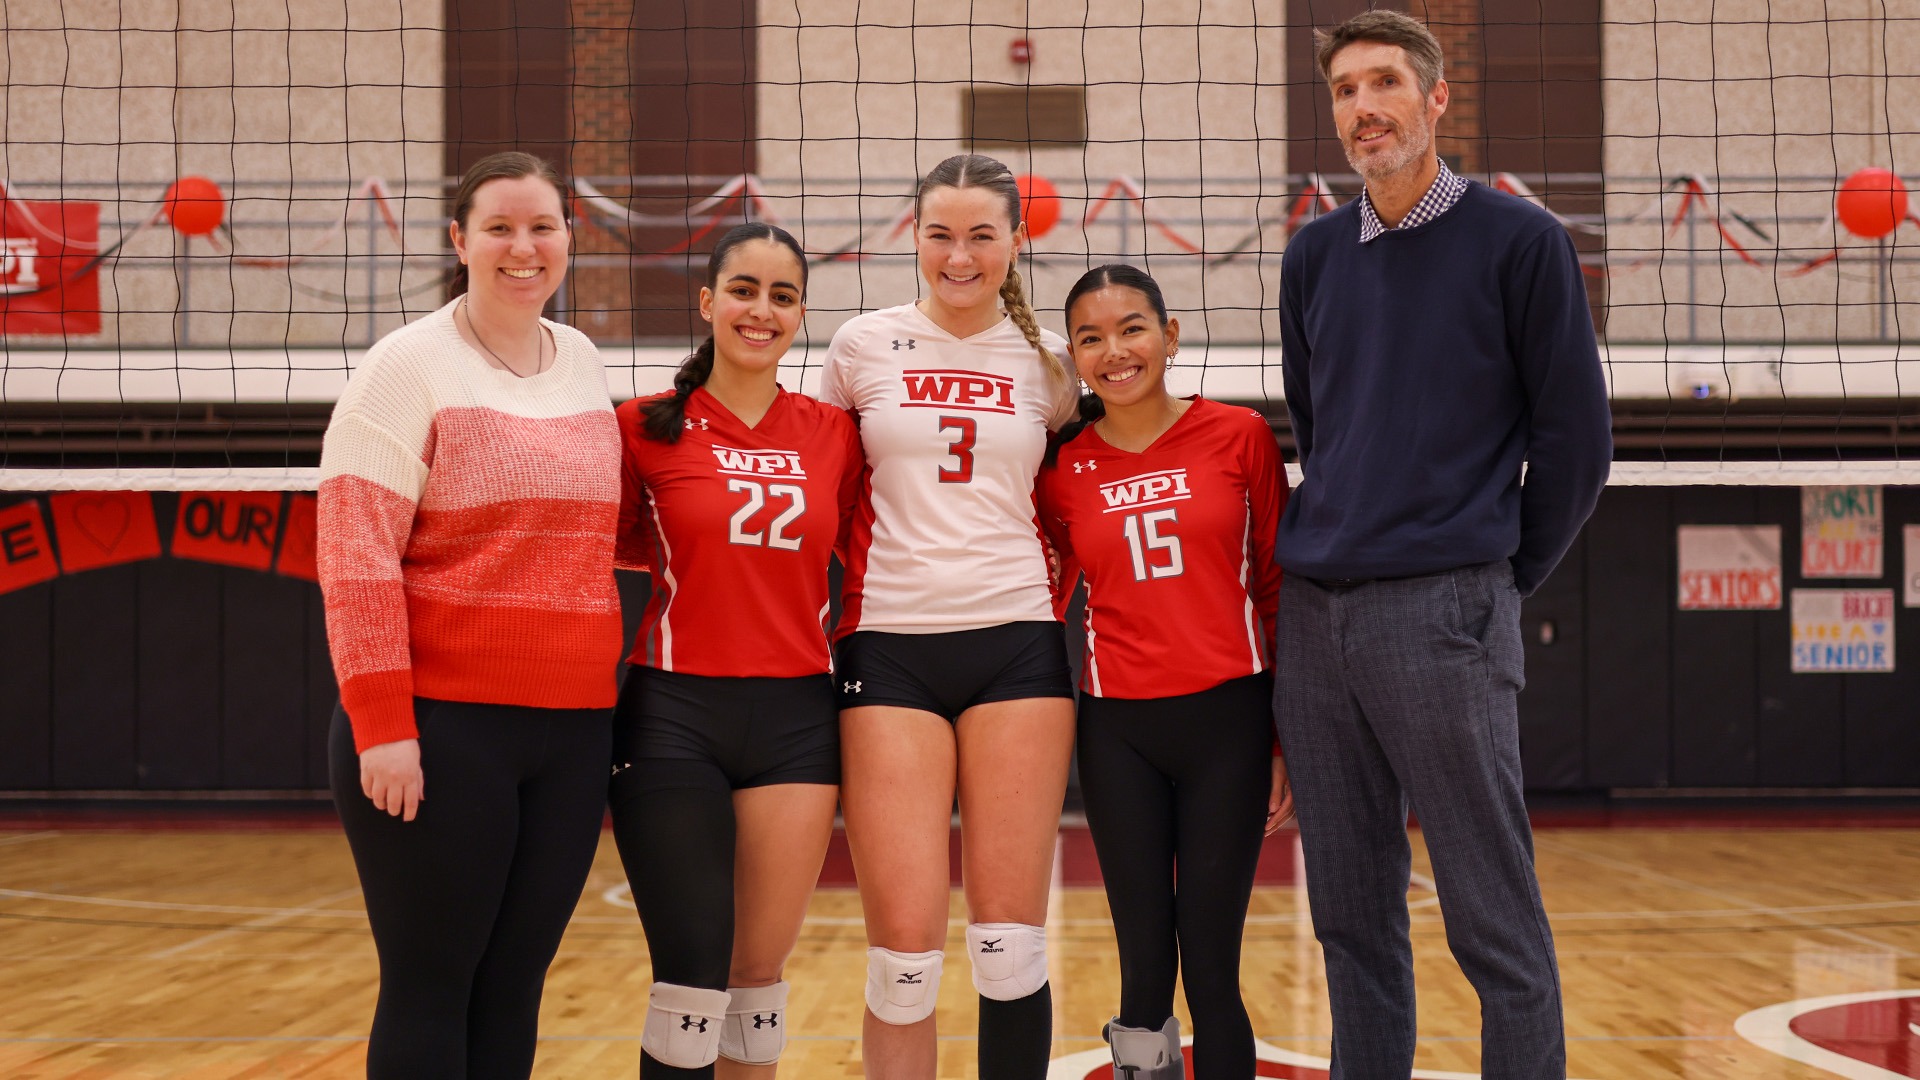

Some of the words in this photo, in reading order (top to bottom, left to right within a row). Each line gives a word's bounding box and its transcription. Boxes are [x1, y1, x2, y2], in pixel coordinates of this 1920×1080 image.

[901, 375, 1015, 409] WPI
[712, 449, 806, 475] WPI
[938, 415, 977, 483] 3
[1100, 473, 1191, 507] WPI
[184, 497, 273, 548] OUR
[727, 478, 807, 552] 22
[1123, 507, 1184, 582] 15
[1681, 567, 1781, 608] SENIORS
[1794, 641, 1886, 666] SENIOR
